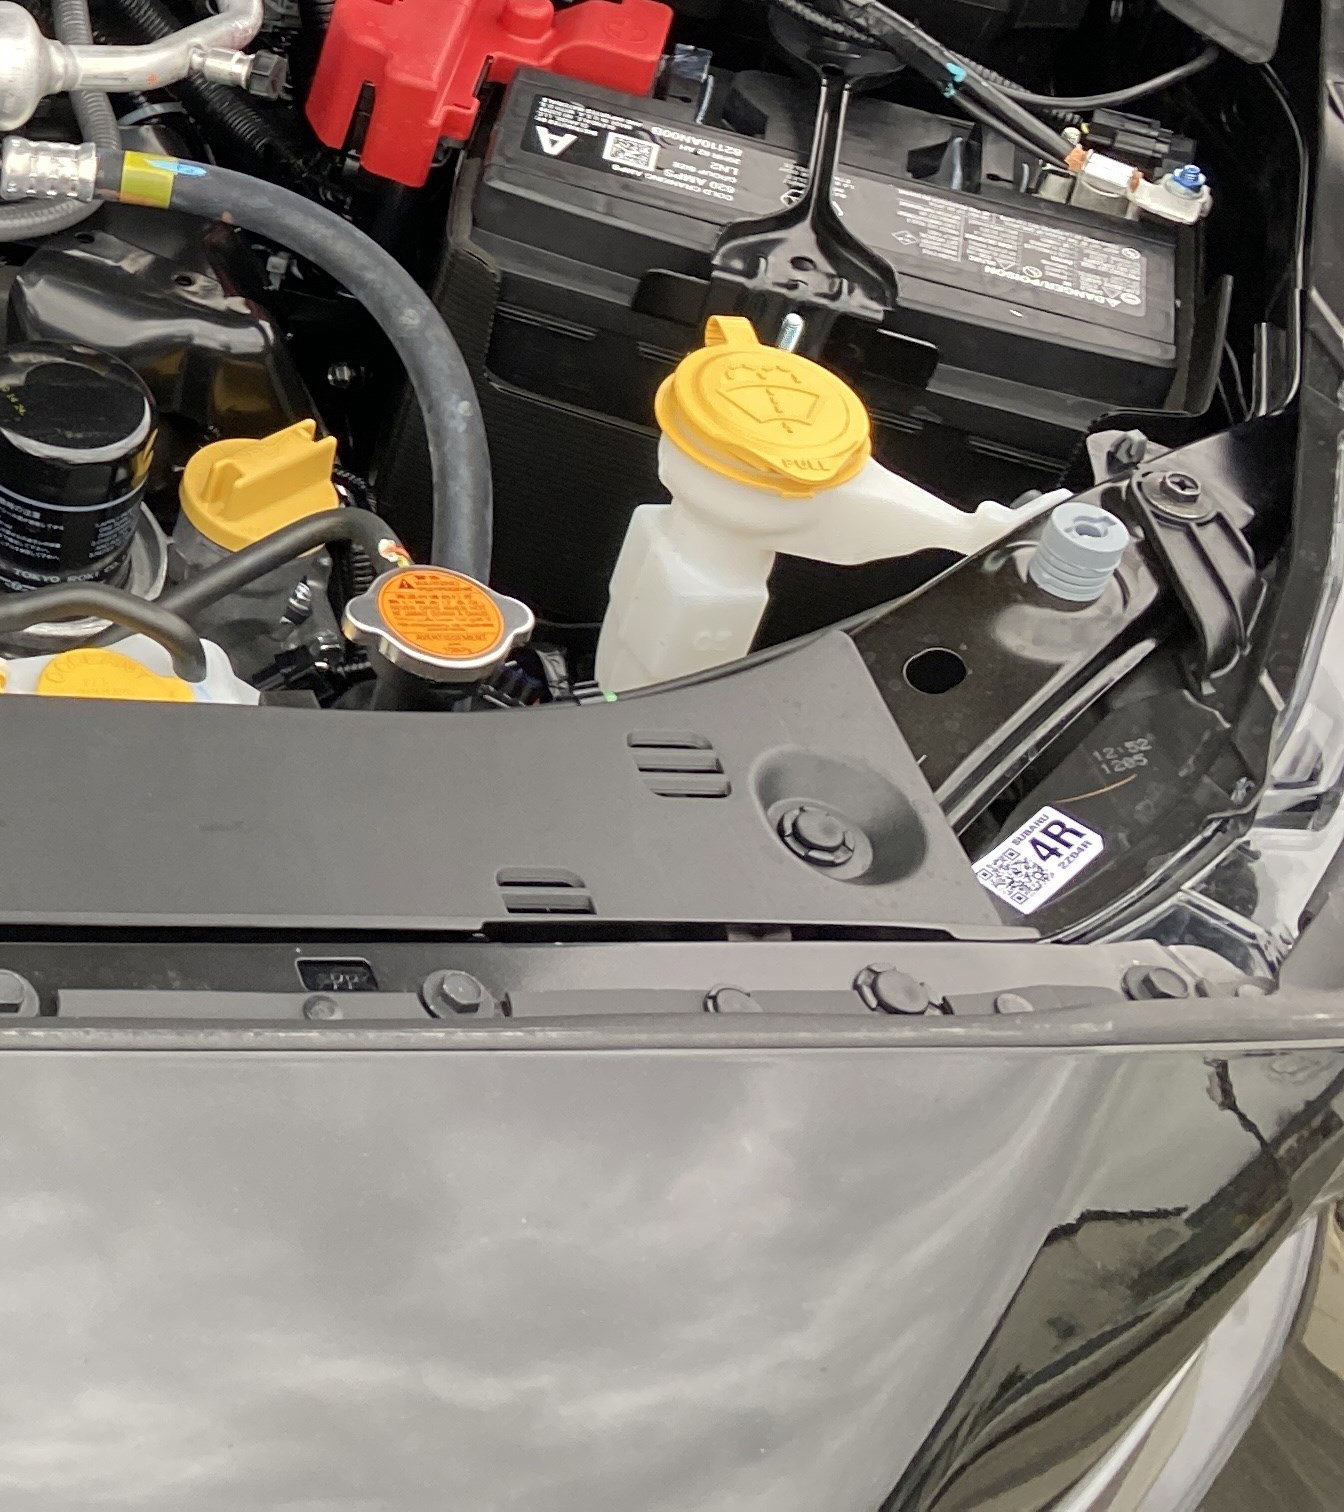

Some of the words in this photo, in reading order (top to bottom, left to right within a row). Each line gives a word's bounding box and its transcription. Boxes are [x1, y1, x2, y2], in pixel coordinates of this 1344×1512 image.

[535, 125, 578, 156] A
[611, 163, 644, 177] AMPS
[697, 168, 737, 183] GROUP
[710, 161, 739, 175] LN2
[644, 172, 702, 193] CRANKING
[662, 169, 707, 187] AMPS
[702, 188, 734, 201] COLD
[984, 265, 1106, 304] DANGER/POISON
[13, 568, 61, 584] TOKYO
[1011, 813, 1049, 846] SUBARU
[1028, 819, 1086, 862] 4R
